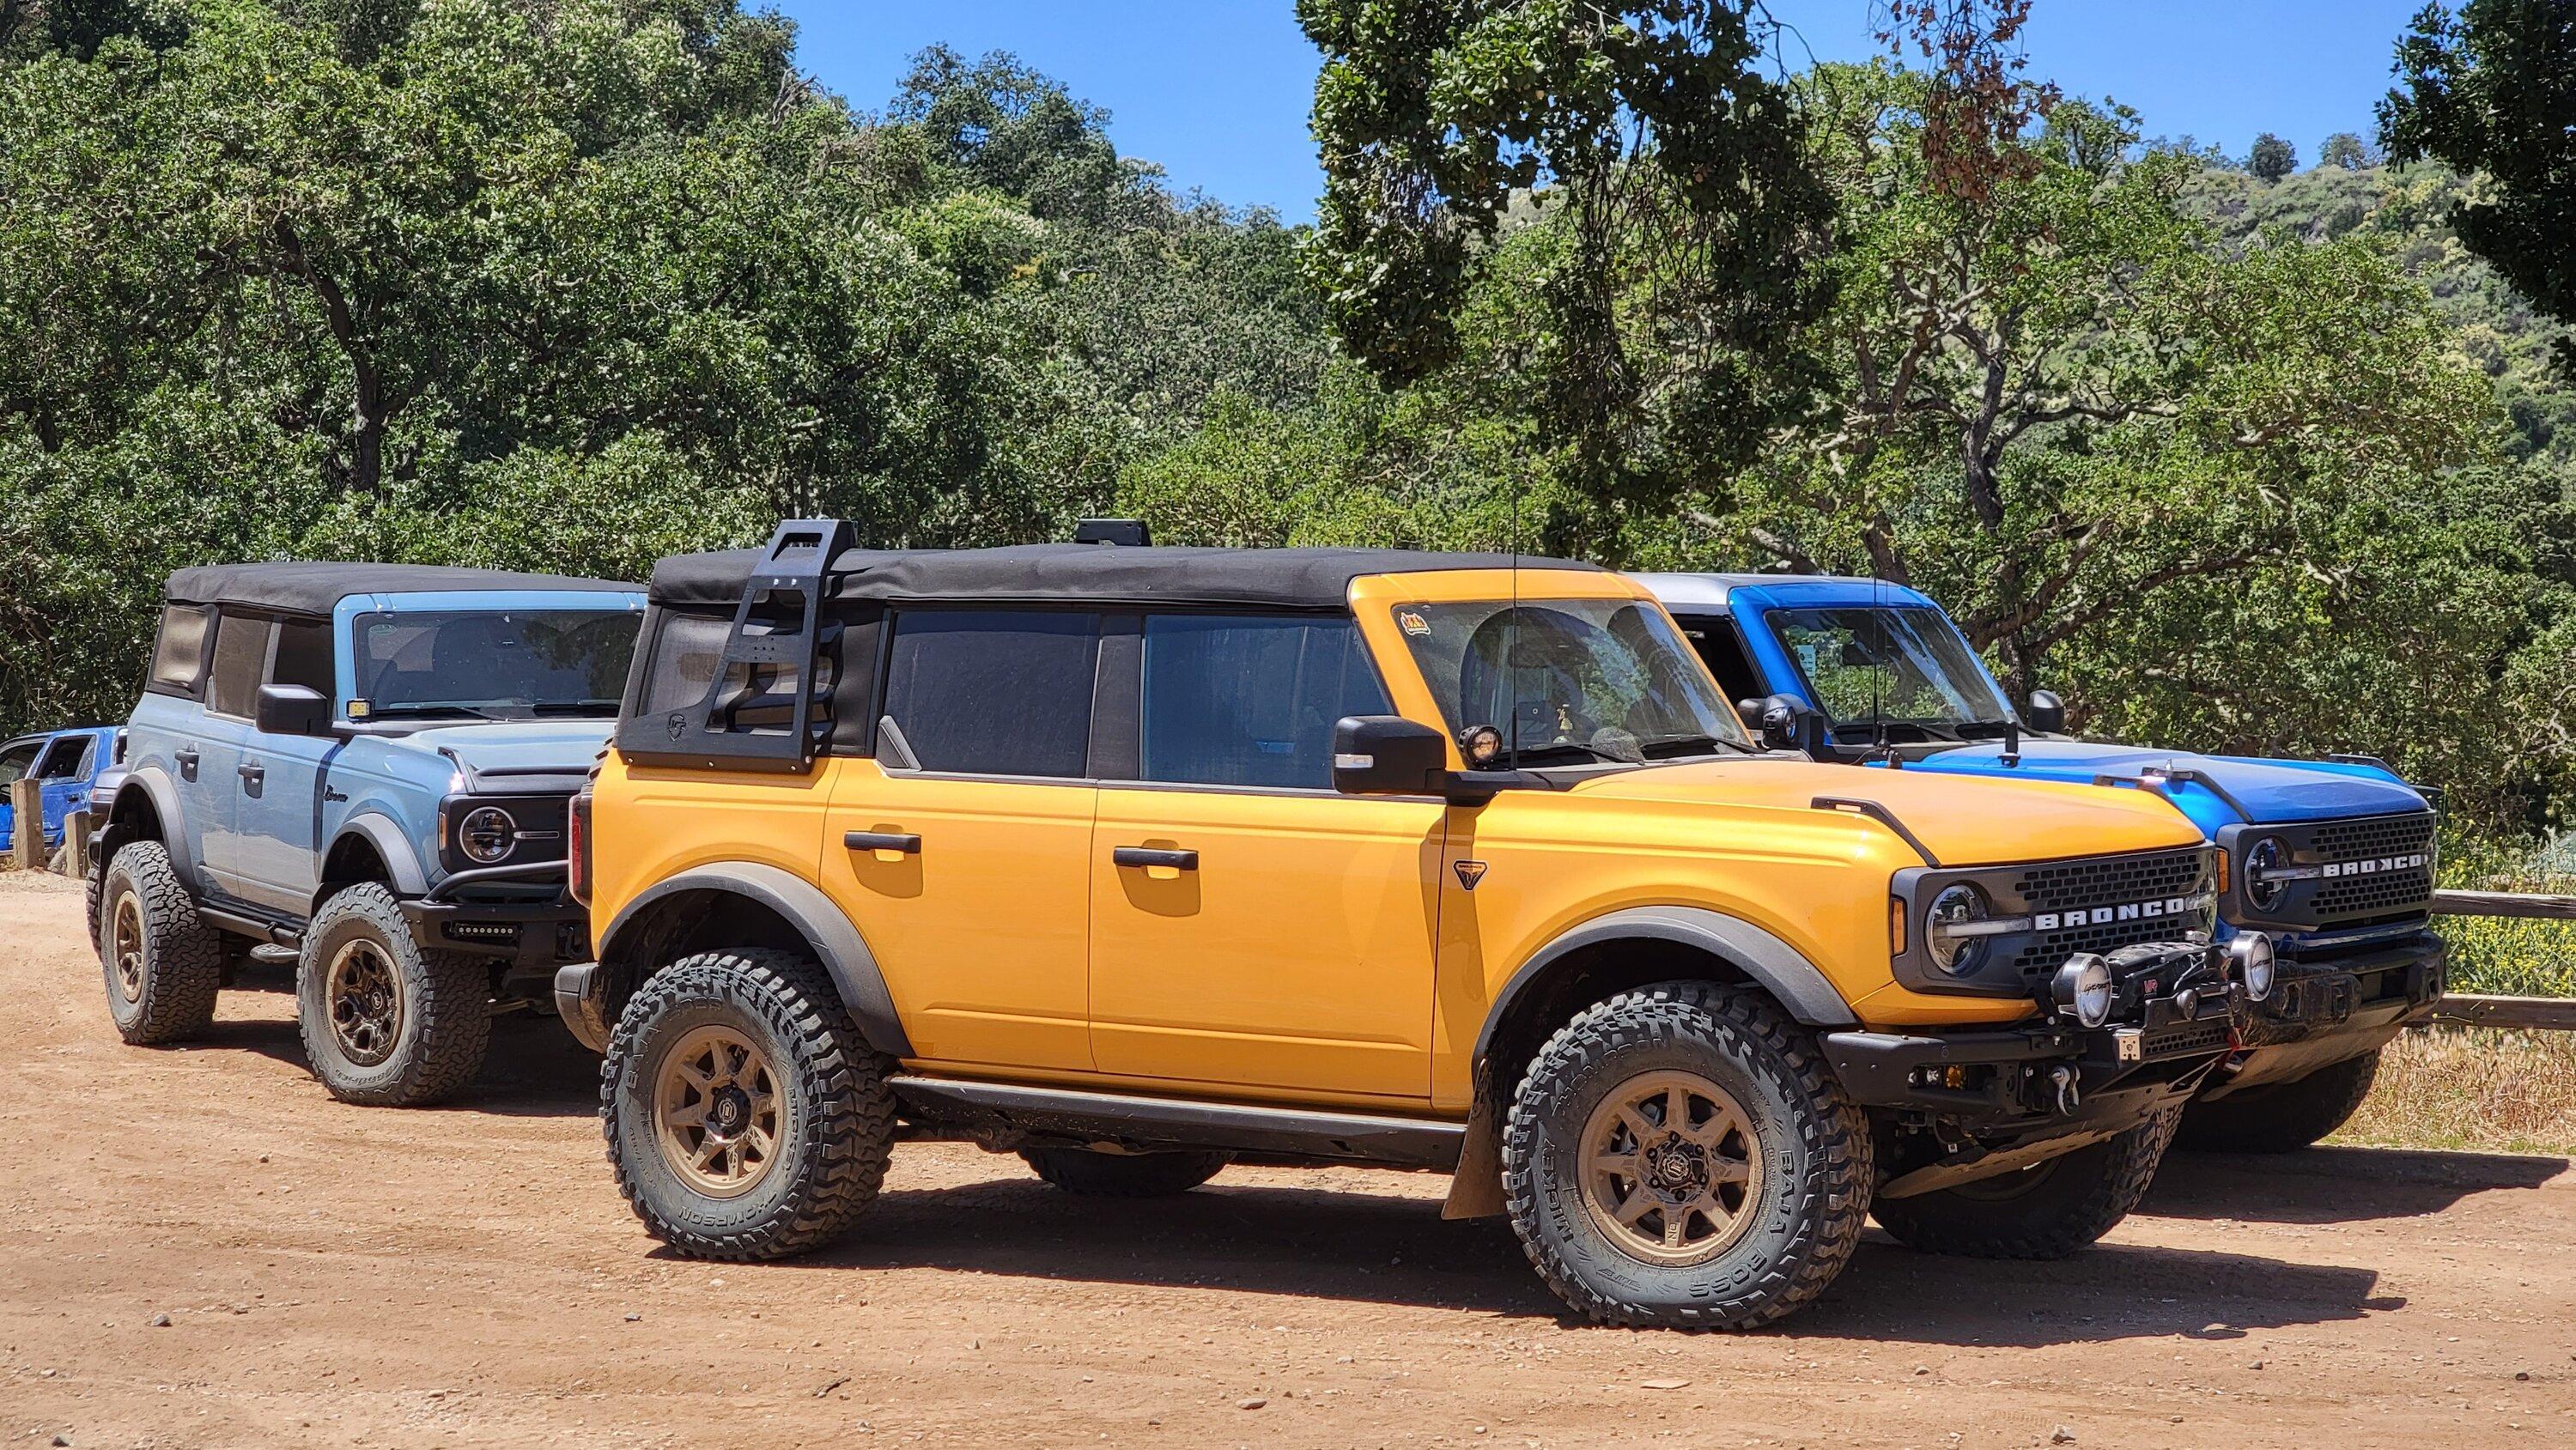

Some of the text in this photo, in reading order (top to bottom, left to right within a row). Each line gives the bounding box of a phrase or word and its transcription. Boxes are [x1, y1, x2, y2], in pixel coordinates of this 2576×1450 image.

[2035, 898, 2184, 931] BRONCO
[1541, 1138, 1575, 1243] MICKEY
[1689, 1149, 1795, 1298] BAJA BOSS
